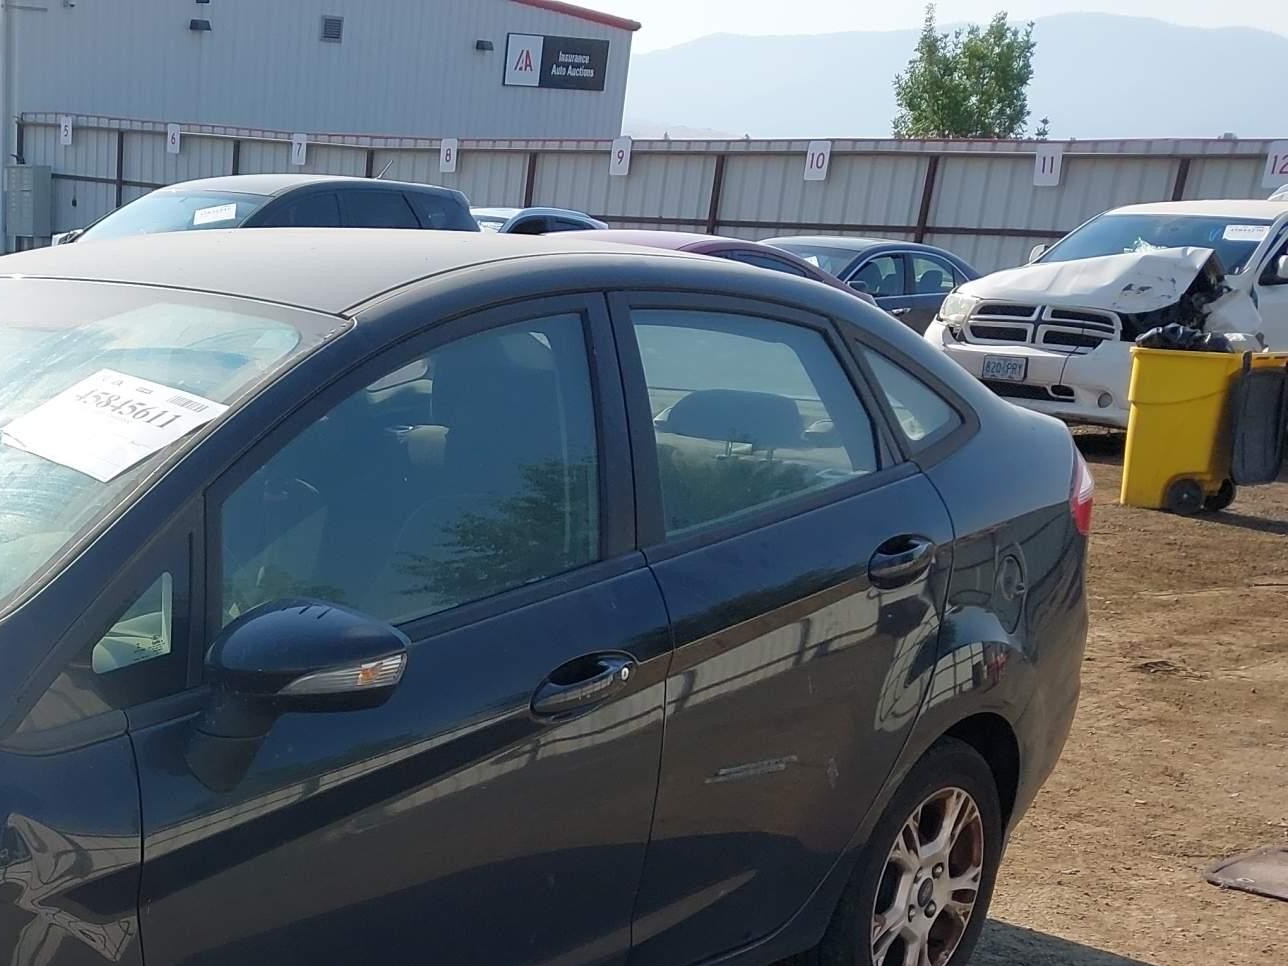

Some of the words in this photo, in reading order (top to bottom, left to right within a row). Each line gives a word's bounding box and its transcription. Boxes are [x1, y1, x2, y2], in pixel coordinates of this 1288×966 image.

[558, 51, 590, 64] Insurance
[551, 64, 566, 75] Auto
[566, 65, 594, 77] Auctions
[63, 124, 69, 137] 5
[170, 133, 176, 145] 6
[296, 143, 302, 155] 7
[444, 149, 452, 163] 8
[617, 150, 624, 165] 9
[810, 152, 825, 169] 10
[1041, 156, 1054, 174] 11
[1271, 154, 1288, 175] 12
